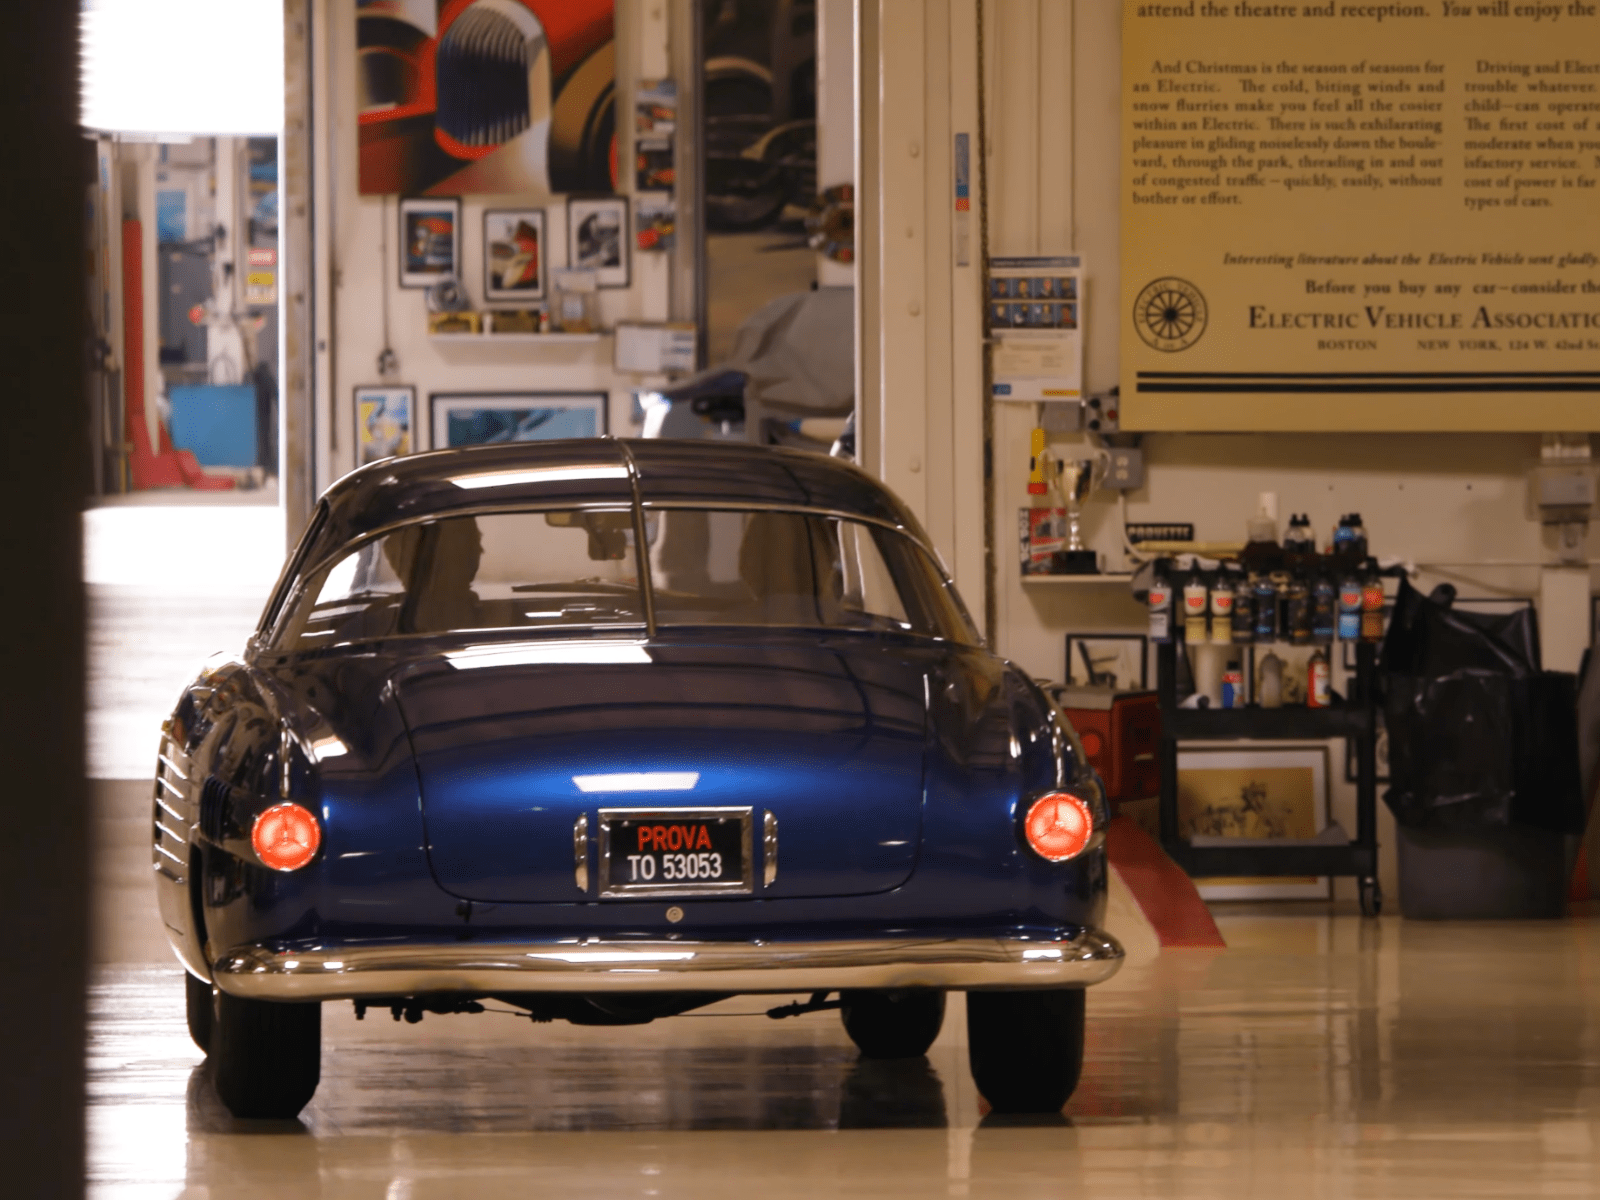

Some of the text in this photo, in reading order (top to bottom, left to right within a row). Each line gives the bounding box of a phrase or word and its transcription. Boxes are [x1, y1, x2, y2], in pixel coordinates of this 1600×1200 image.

[1137, 0, 1195, 17] attend
[1200, 0, 1229, 17] the
[1233, 0, 1298, 17] theatre
[1302, 0, 1336, 17] and
[1441, 0, 1472, 17] You
[1476, 0, 1510, 17] will
[1514, 2, 1563, 22] enjoy
[1567, 0, 1597, 17] the
[1151, 60, 1445, 74] And Christmas is the season of seasons for
[1476, 60, 1531, 77] Driving
[1534, 60, 1561, 74] and
[1132, 83, 1151, 93] an
[1238, 78, 1266, 93] The
[1315, 79, 1362, 96] biting
[1367, 79, 1411, 93] winds
[1417, 79, 1446, 93] and
[1464, 79, 1518, 93] trouble
[1132, 98, 1443, 114] snow flurries make you feel all the cosier
[1132, 117, 1177, 130] within
[1181, 121, 1198, 131] an
[1267, 116, 1306, 131] There
[1309, 120, 1321, 130] is
[1324, 117, 1357, 130] such
[1359, 117, 1443, 134] exhilarating
[1464, 116, 1491, 131] The
[1499, 117, 1528, 131] first
[1535, 120, 1565, 131] cost
[1572, 117, 1590, 131] of
[1132, 136, 1442, 153] pleasure in gliding noiselessly down the boule-
[1464, 136, 1533, 150] moderate
[1536, 137, 1575, 150] when
[1172, 155, 1228, 171] through
[1231, 155, 1254, 168] the
[1298, 155, 1366, 171] threading
[1370, 157, 1385, 168] in
[1389, 154, 1416, 168] and
[1419, 158, 1444, 168] out
[1464, 155, 1524, 171] isfactory
[1132, 173, 1148, 186] of
[1151, 173, 1221, 190] congested
[1388, 173, 1443, 187] without
[1464, 175, 1597, 191] cost of power is far
[1132, 192, 1178, 205] bother
[1181, 195, 1197, 205] or
[1464, 197, 1501, 211] types
[1503, 193, 1519, 207] of
[1305, 279, 1356, 294] Before
[1363, 284, 1392, 298] you
[1398, 279, 1427, 298] buy
[1434, 284, 1462, 298] any
[1248, 305, 1360, 329] ELECTRIC
[1363, 305, 1463, 329] VEHICLE
[1317, 339, 1377, 350] BOSTON
[637, 825, 712, 851] PROVA
[627, 853, 722, 880] TO 53053
